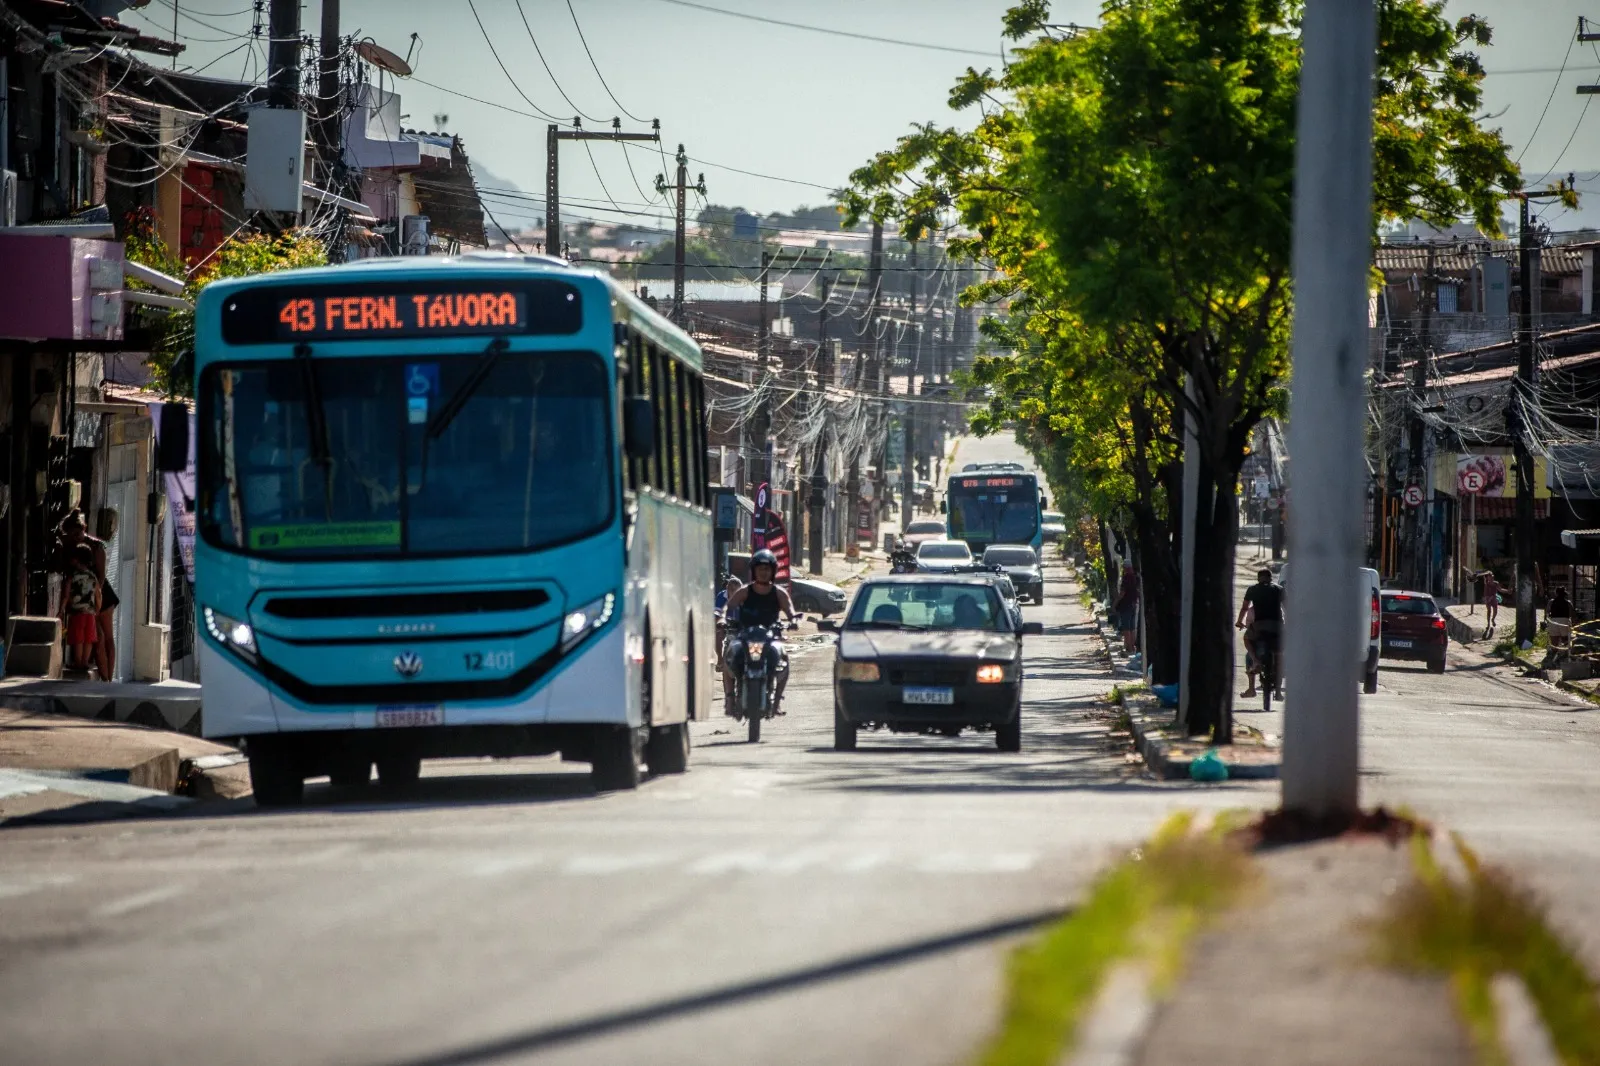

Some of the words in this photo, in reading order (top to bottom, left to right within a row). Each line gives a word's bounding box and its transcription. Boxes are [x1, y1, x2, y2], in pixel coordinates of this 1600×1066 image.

[279, 299, 315, 331] 43
[325, 296, 403, 330] FERN.
[412, 291, 517, 327] TÁVORA
[463, 650, 516, 671] 12401
